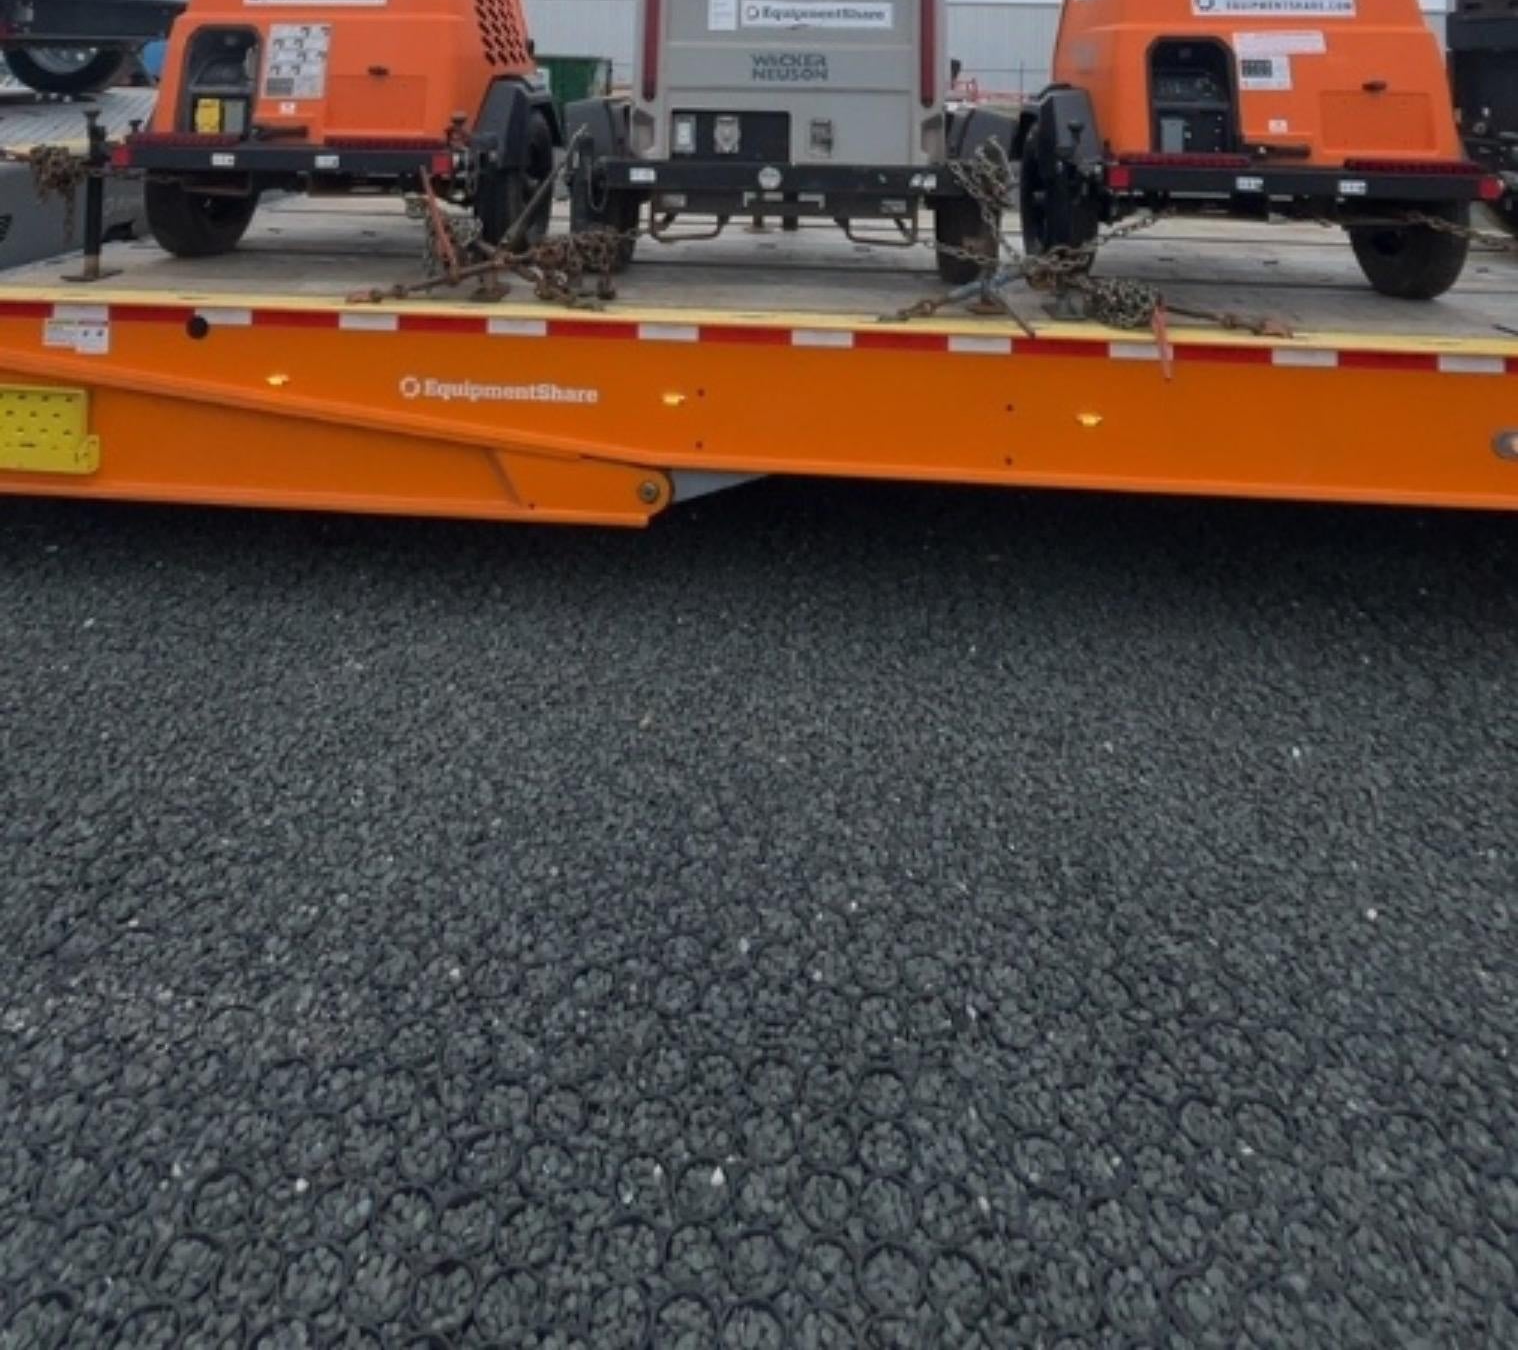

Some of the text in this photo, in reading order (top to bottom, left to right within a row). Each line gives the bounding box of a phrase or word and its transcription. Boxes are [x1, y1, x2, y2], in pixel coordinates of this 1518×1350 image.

[762, 5, 886, 21] EquipmentShare
[752, 53, 827, 67] WACKER
[752, 68, 829, 81] NEUSON
[425, 378, 599, 403] EquipmentShare
